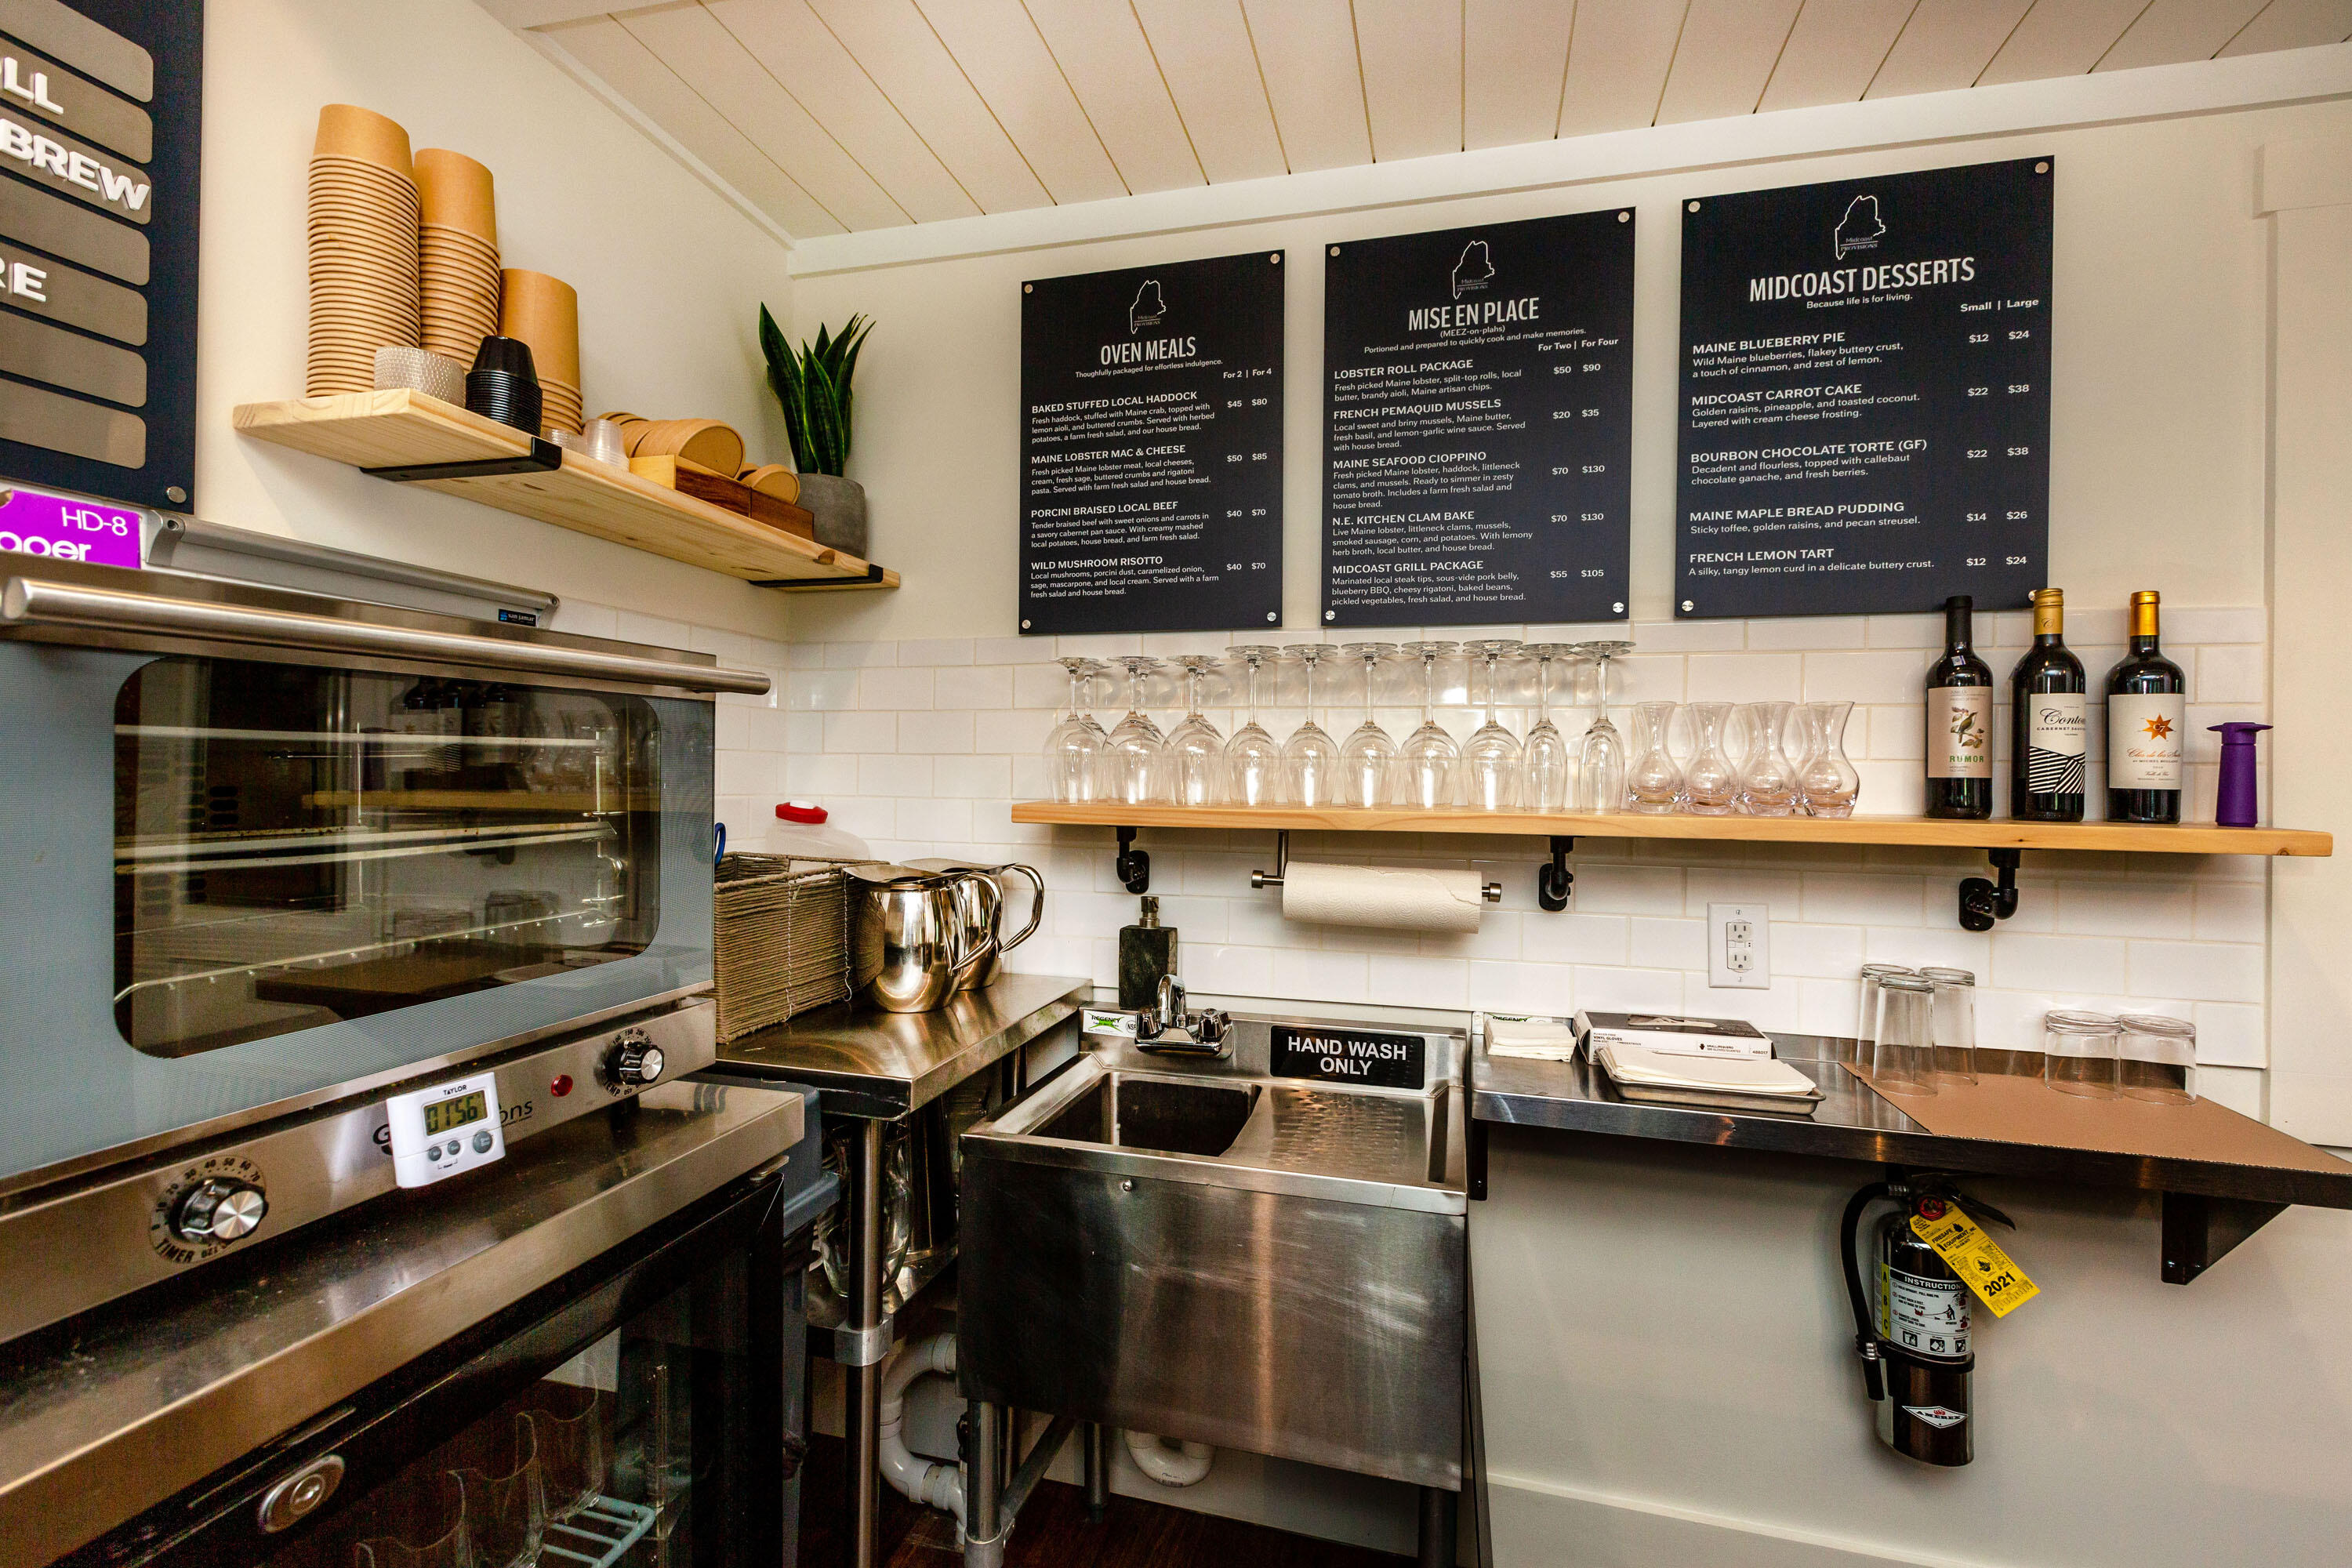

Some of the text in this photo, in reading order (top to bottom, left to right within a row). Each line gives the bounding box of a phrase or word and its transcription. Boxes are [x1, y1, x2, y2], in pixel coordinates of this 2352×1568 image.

[0, 56, 64, 115] LL
[0, 118, 151, 211] BREW
[1750, 257, 1975, 301] MIDCOAST DESSERTS
[1806, 300, 1844, 309] Because
[1960, 299, 2039, 312] Small Large
[1409, 297, 1539, 331] MISE EN PLACE
[1440, 325, 1505, 338] (MEEZ-on-plahs)
[1364, 344, 1399, 354] Portioned
[1416, 339, 1448, 350] prepared
[1458, 336, 1485, 346] quickly
[1546, 328, 1586, 337] memories.
[1693, 332, 1846, 354] MAINE BLUEBERRY PIE
[1101, 336, 1196, 365] OVEN MEALS
[1112, 365, 1143, 376] packaged
[1334, 359, 1473, 379] LOBSTER ROLL PACKAGE
[1554, 363, 1601, 375] $50 $90
[1032, 391, 1197, 413] BAKED STUFFED LOCAL HADDOCK
[1692, 384, 1862, 405] MIDCOAST CARROT CAKE
[1334, 399, 1501, 419] FRENCH PEMAQUID MUSSELS
[1552, 408, 1599, 419] $20 $35
[1692, 418, 1729, 429] Layered
[1731, 416, 1751, 425] with
[1822, 409, 1862, 419] frosting.
[1032, 445, 1185, 463] MAINE LOBSTER MAC & CHEESE
[1691, 439, 1927, 463] BOURBON CHOCOLATE TORTE (GF)
[1334, 452, 1486, 469] MAINE SEAFOOD CIOPPINO
[1582, 465, 1605, 474] $130
[1031, 501, 1178, 517] PORCINI BRAISED LOCAL BEEF
[1690, 502, 1904, 521] MAINE MAPLE BREAD PUDDING
[61, 506, 129, 536] HD-8
[1333, 511, 1474, 525] N.E. KITCHEN CLAM BAKE
[1551, 513, 1604, 523] $70 $130
[1031, 556, 1163, 570] WILD MUSHROOM RISOTTO
[1690, 548, 1835, 563] FRENCH LEMON TART
[1333, 561, 1483, 574] MIDCOAST GRILL PACKAGE
[2153, 723, 2165, 732] C7
[1288, 1036, 1406, 1061] HAND WASH
[1320, 1057, 1372, 1076] ONLY
[443, 1084, 467, 1095] TAYLOR
[1932, 1228, 1953, 1243] FIRESAFE
[154, 1237, 195, 1263] TIMER
[1883, 1272, 1887, 1283] A
[1904, 1276, 1963, 1290] INSTRUCTION
[1984, 1271, 2016, 1297] 2021
[1883, 1295, 1888, 1305] B
[1884, 1319, 1888, 1330] C
